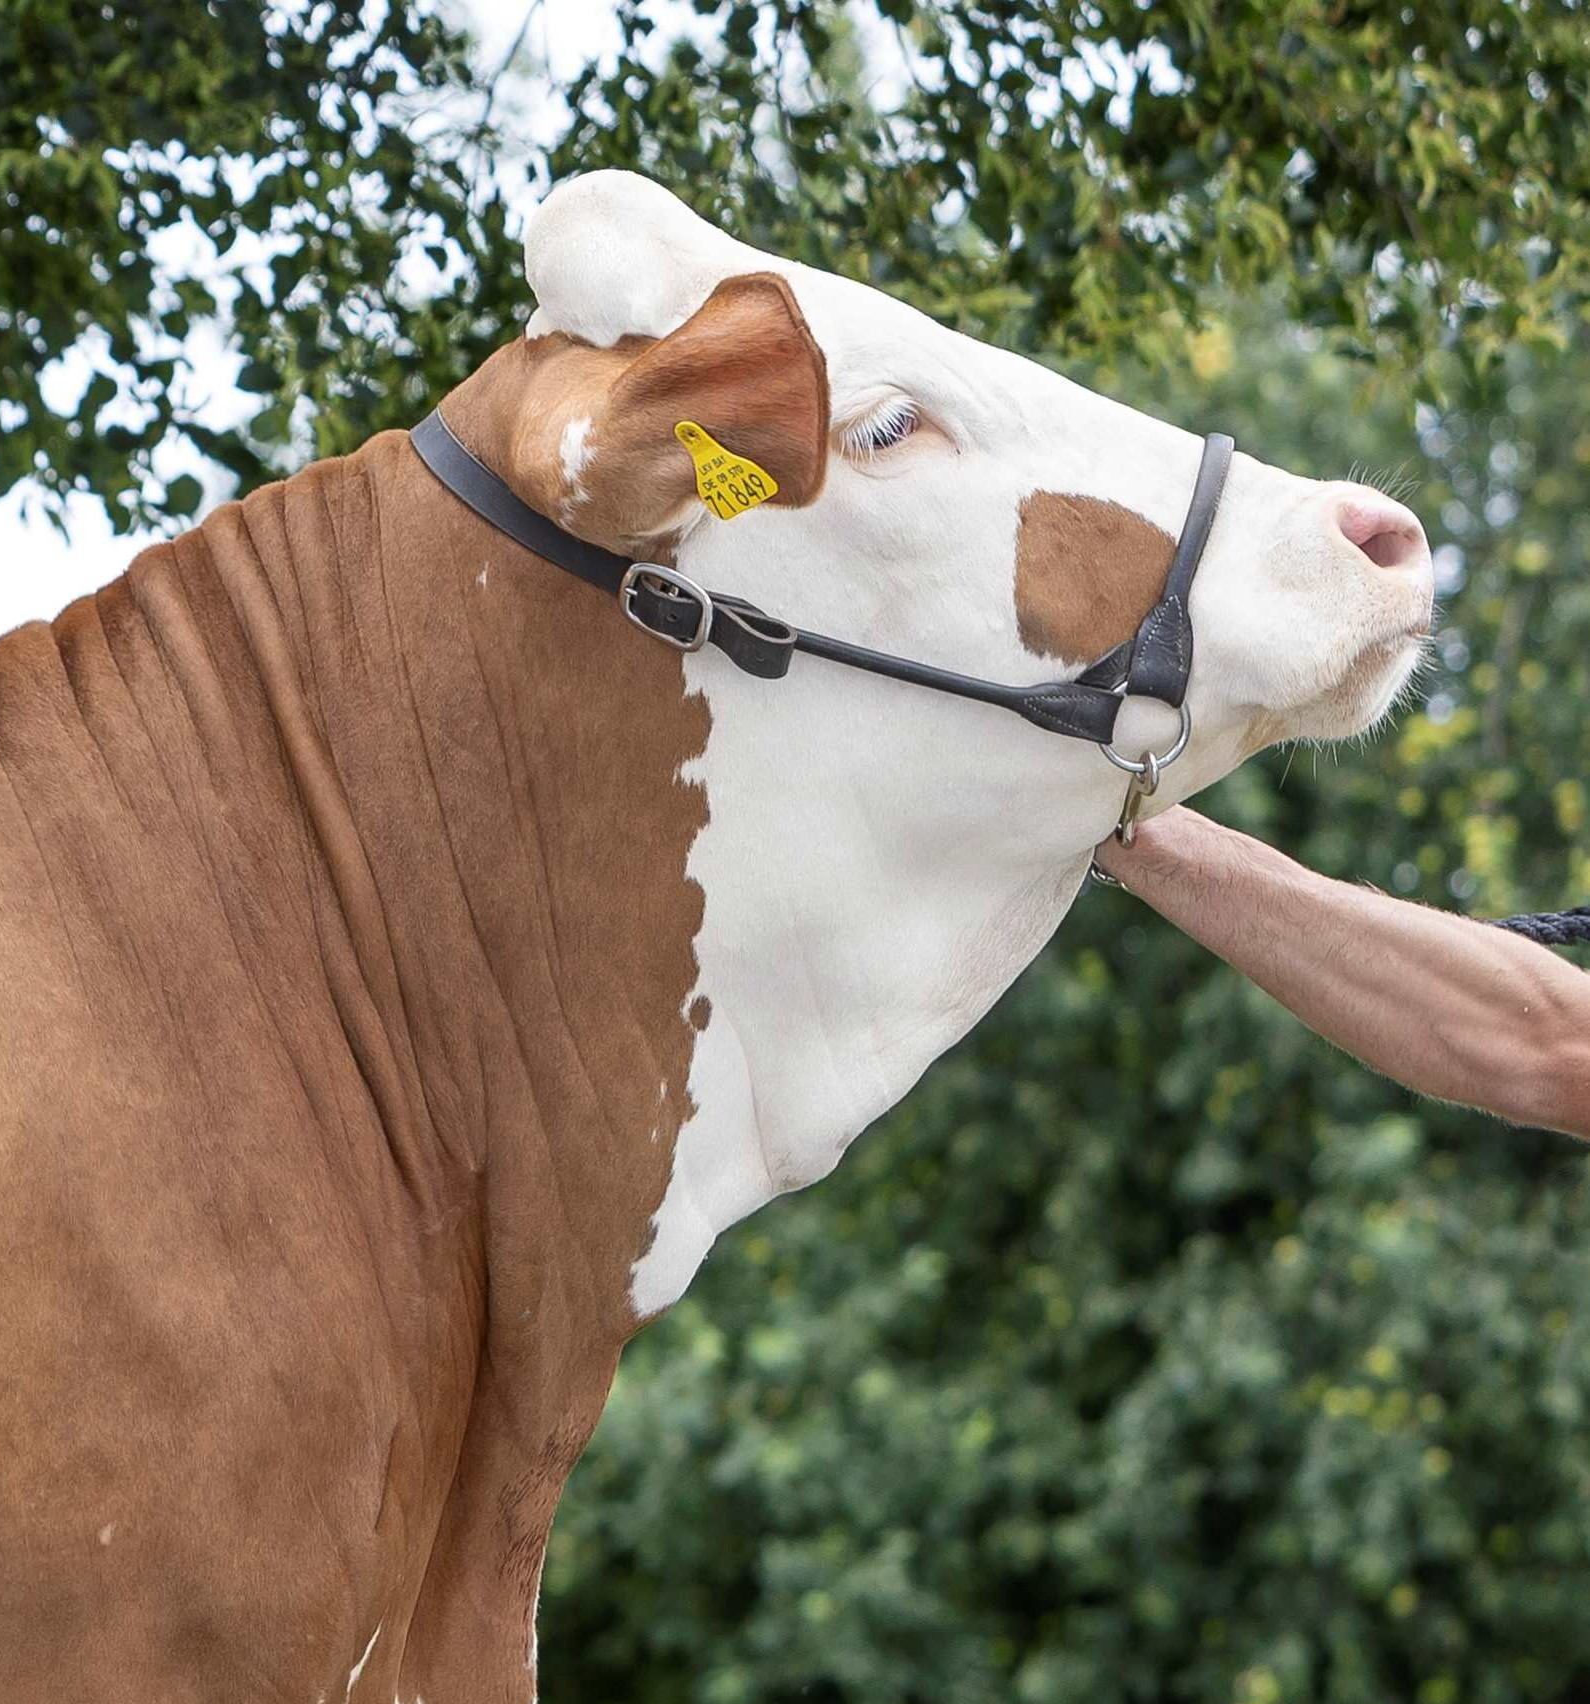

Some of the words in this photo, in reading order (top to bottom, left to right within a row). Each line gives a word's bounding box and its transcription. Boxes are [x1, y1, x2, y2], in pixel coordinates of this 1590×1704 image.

[702, 479, 717, 491] DE
[704, 491, 737, 519] 71
[728, 473, 767, 506] 849
